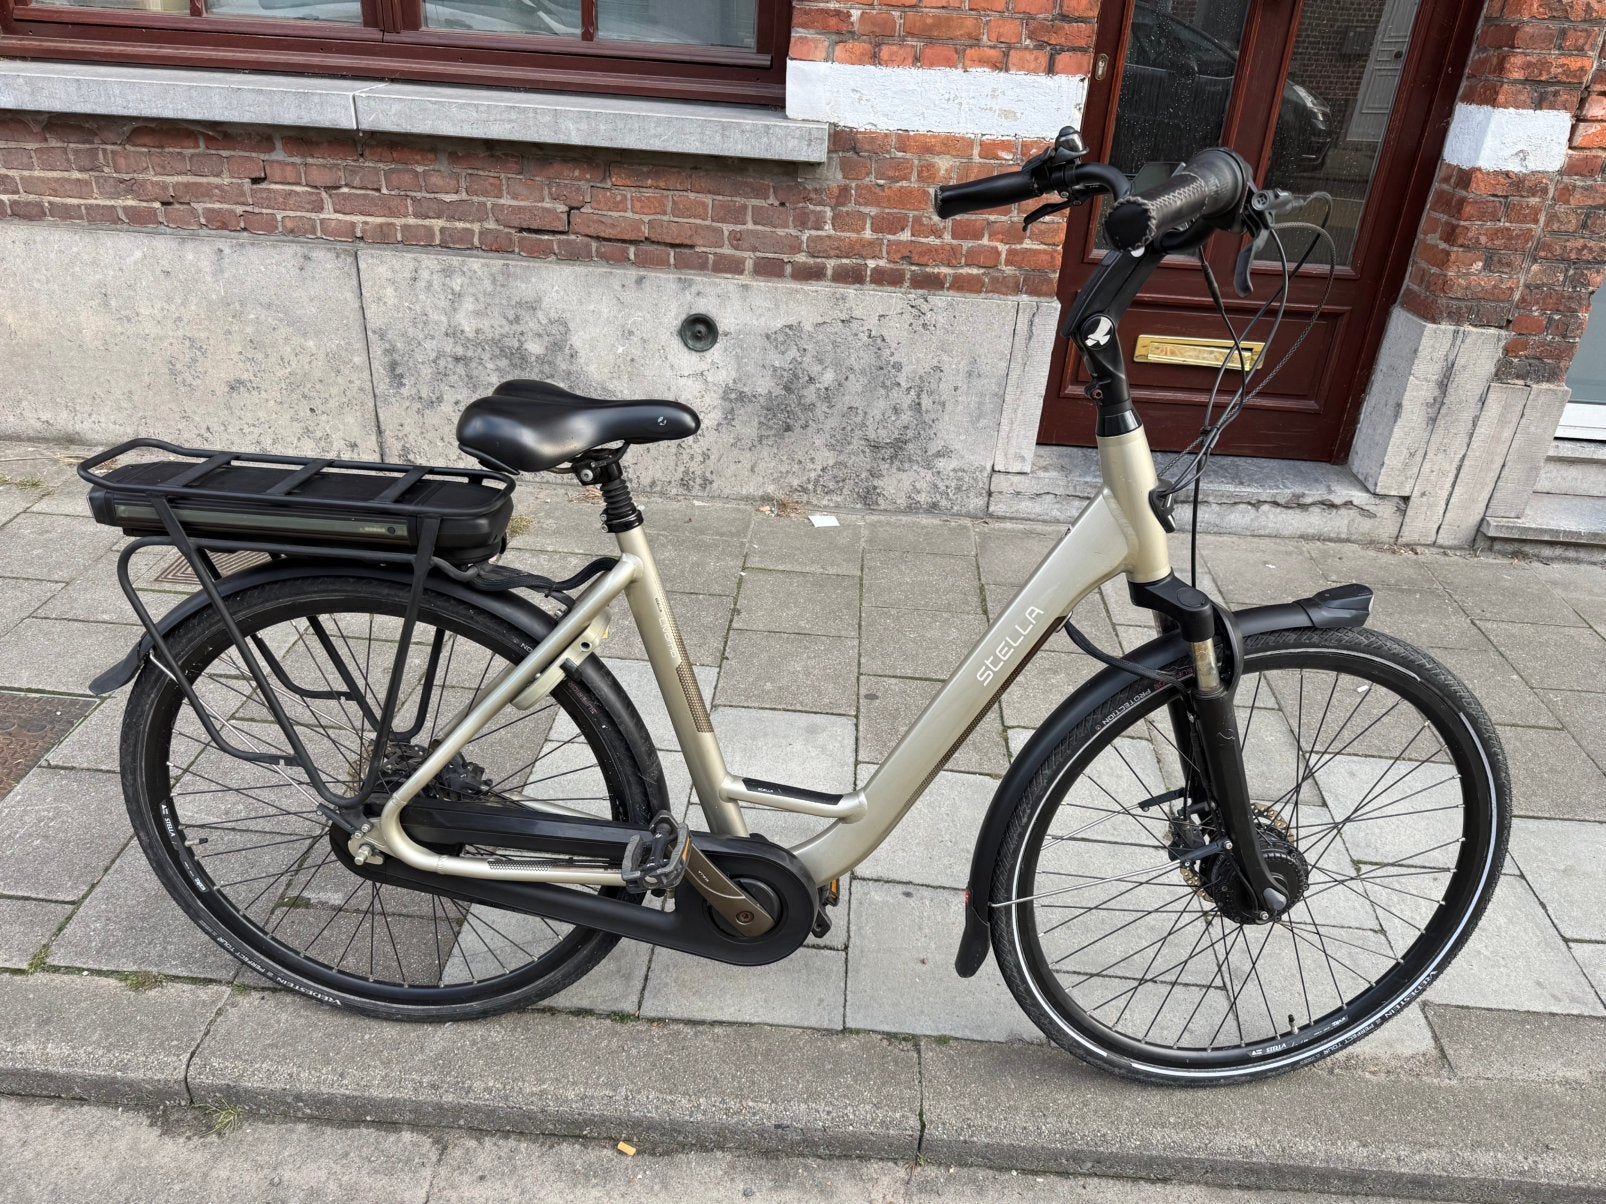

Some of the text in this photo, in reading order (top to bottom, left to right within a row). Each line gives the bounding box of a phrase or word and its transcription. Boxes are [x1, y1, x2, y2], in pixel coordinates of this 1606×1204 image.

[1101, 688, 1152, 726] PROTECTION
[165, 817, 176, 837] STELLA
[217, 937, 342, 1006] VREDESTEIN PERFECT TOUR
[1384, 970, 1438, 1018] VREDESTEIN
[1323, 1042, 1343, 1055] TOUR
[1344, 1024, 1375, 1044] PERFECT
